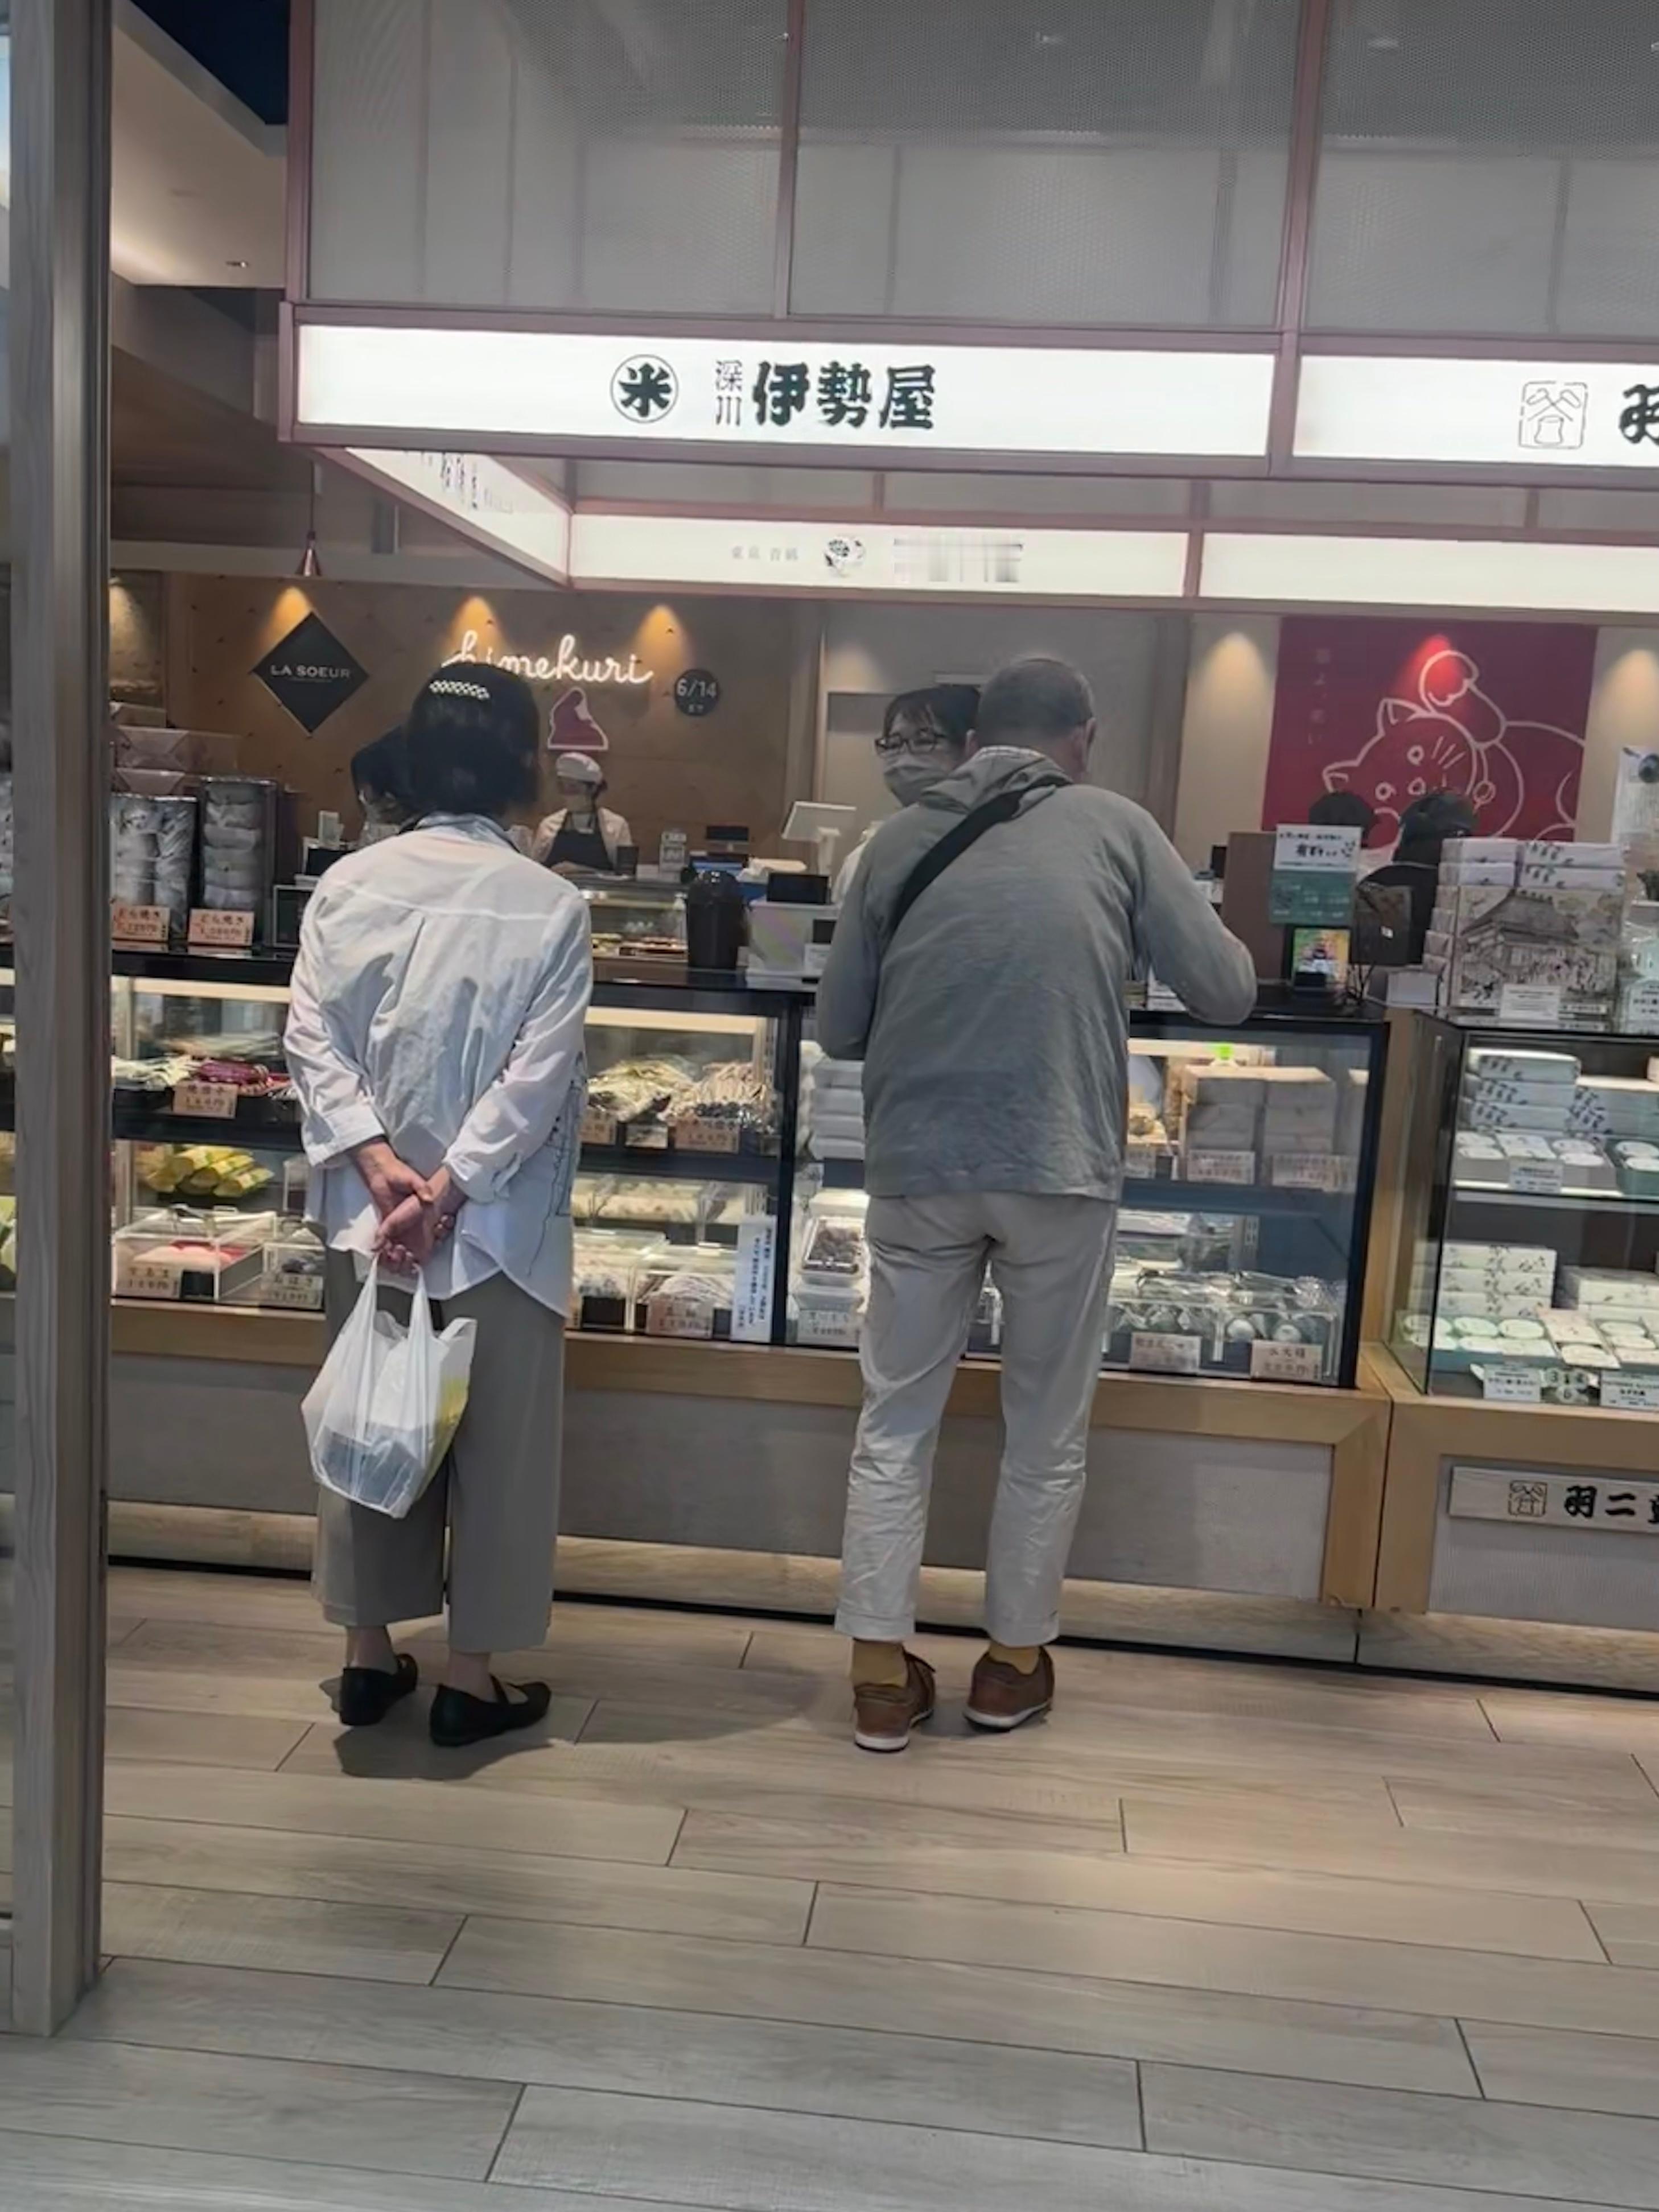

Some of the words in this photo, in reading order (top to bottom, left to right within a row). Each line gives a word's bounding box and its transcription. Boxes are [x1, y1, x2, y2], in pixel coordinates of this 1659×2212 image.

[618, 363, 673, 418] 米
[715, 359, 743, 426] 深川
[752, 360, 936, 430] 伊勢屋
[270, 664, 292, 676] LA
[296, 665, 351, 678] SOEUR
[441, 629, 654, 683] himekuri
[677, 678, 717, 698] 6/14
